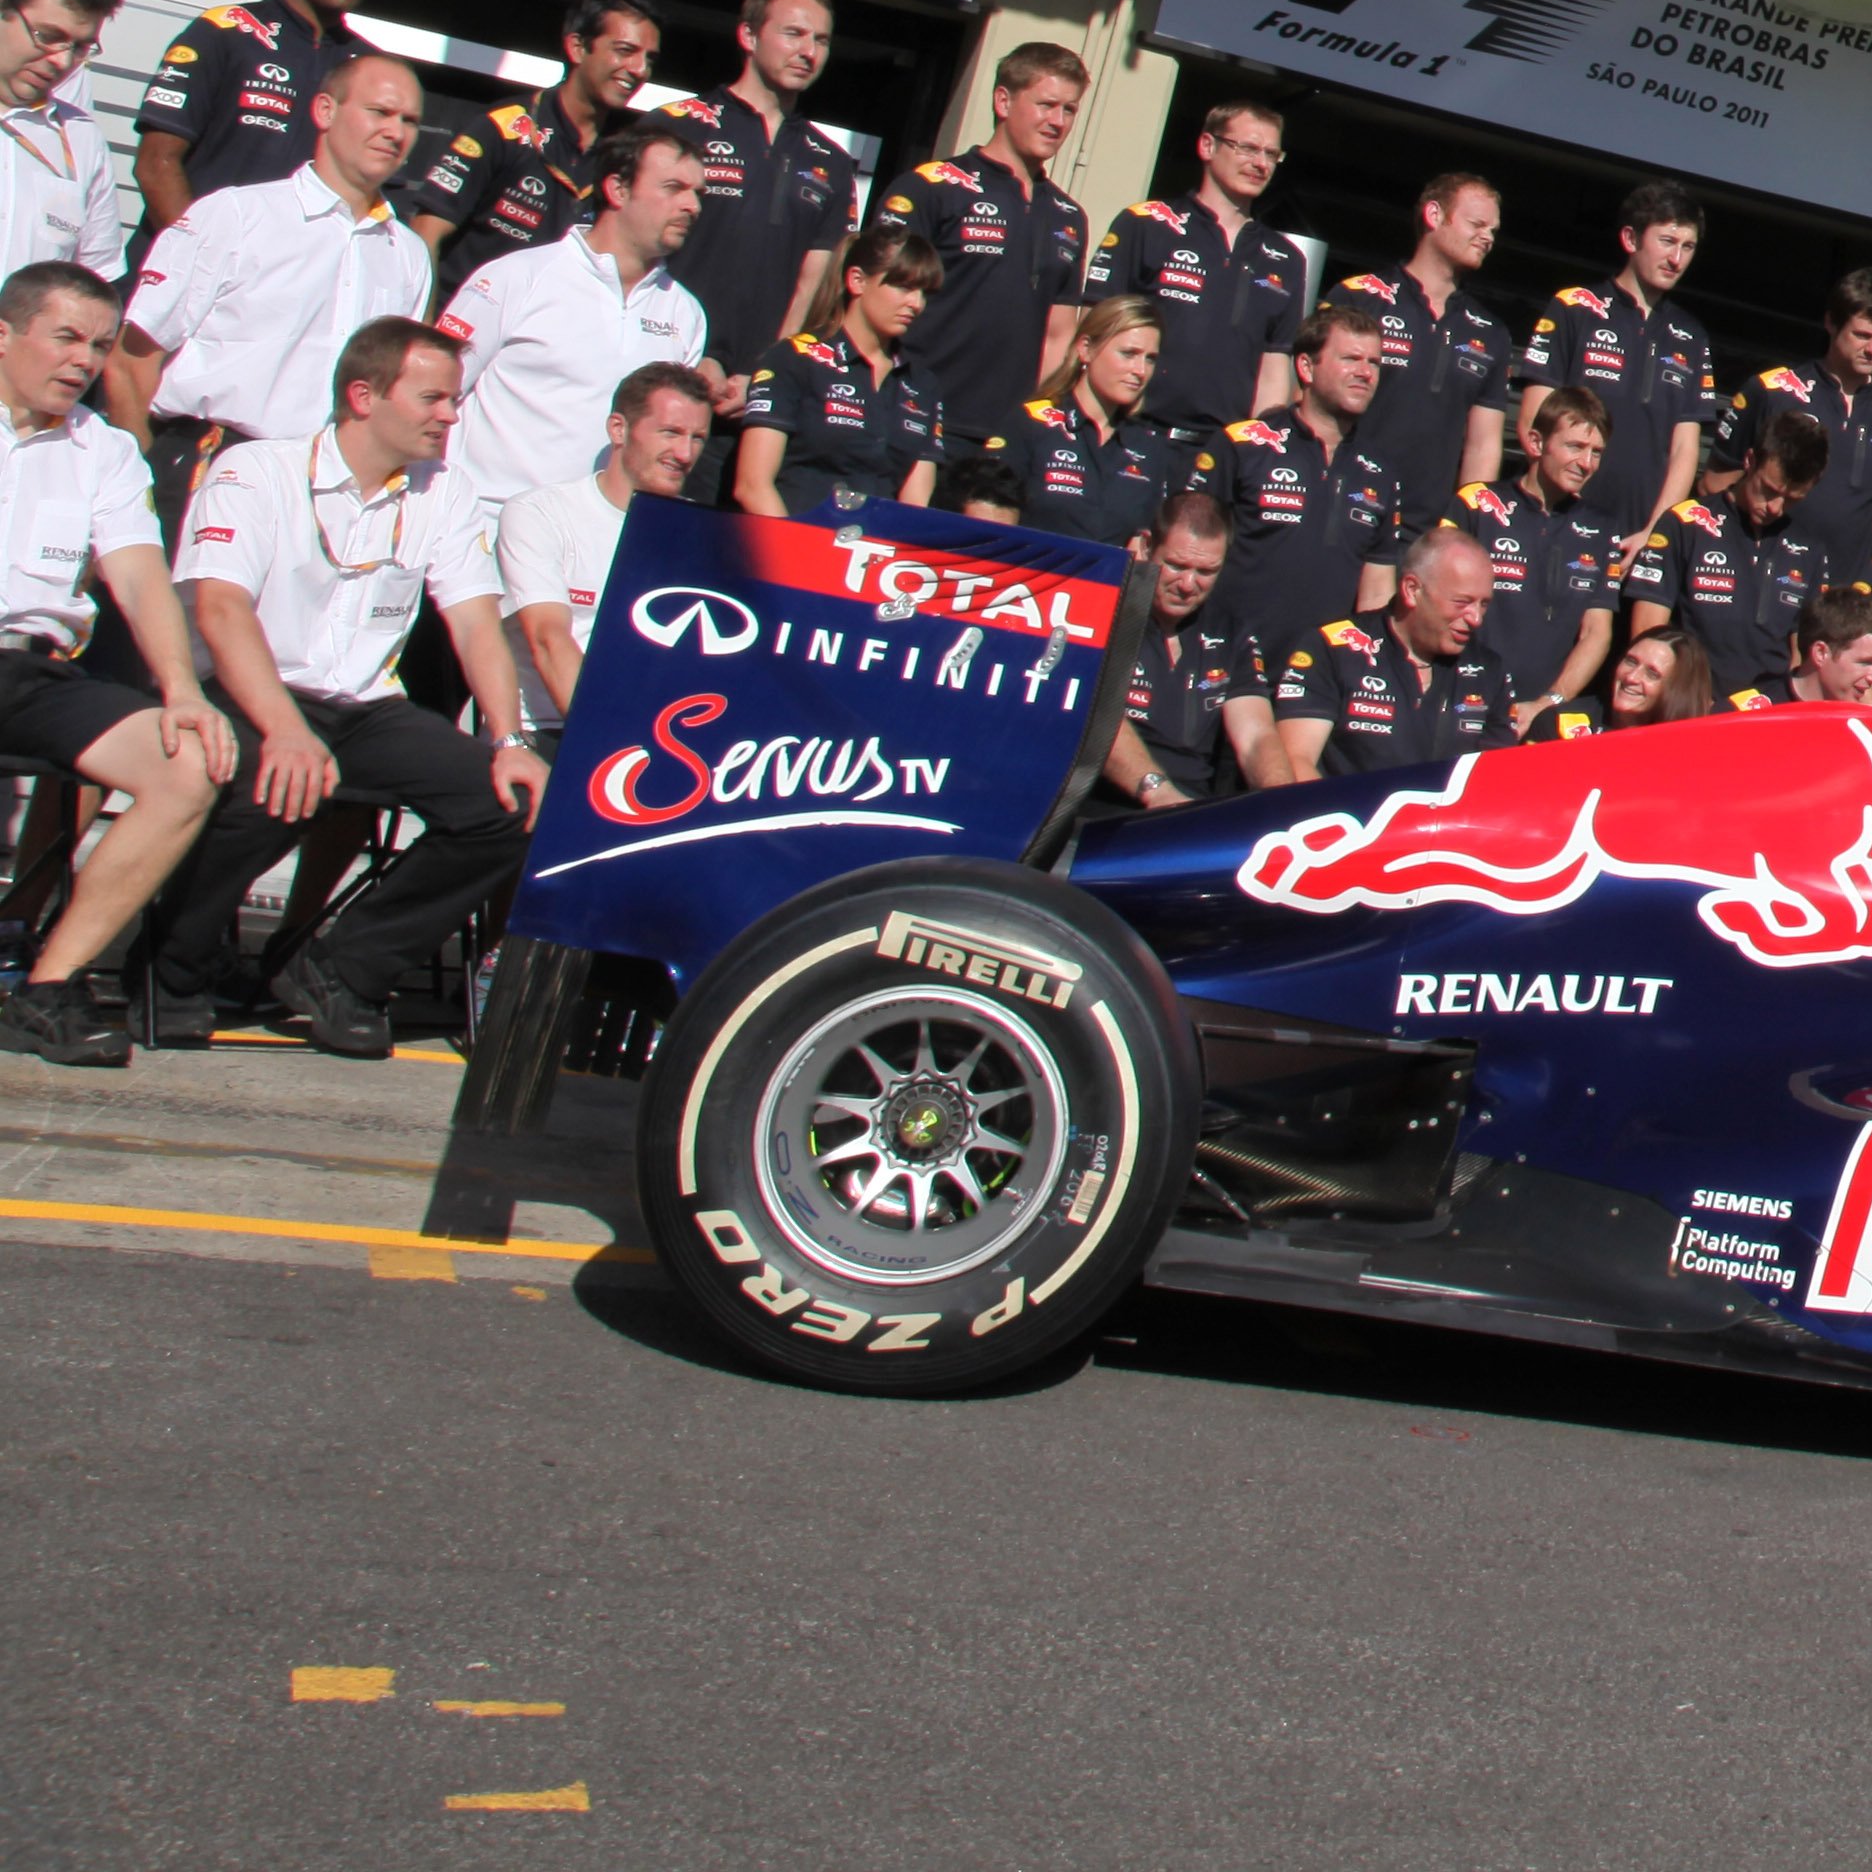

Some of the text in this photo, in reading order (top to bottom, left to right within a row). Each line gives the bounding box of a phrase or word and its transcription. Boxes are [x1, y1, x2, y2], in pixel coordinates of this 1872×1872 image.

[1253, 9, 1451, 78] Formula 1
[1660, 3, 1829, 69] PETROBRAS
[1630, 27, 1785, 91] DO BRASIL
[245, 80, 297, 97] INFINITI
[1586, 63, 1769, 129] SÃO PAULO 2011
[246, 93, 291, 113] TOTAL
[241, 114, 288, 133] GEOX
[501, 201, 538, 225] TOTAL
[964, 217, 1007, 225] INFINITI
[489, 218, 533, 242] GEOX
[966, 229, 1004, 239] TOTAL
[964, 244, 1004, 255] GEOX
[1164, 272, 1201, 288] TOTAL
[1160, 288, 1200, 304] GEOX
[1585, 343, 1625, 354] INFINITI
[1381, 356, 1409, 367] EOX
[1589, 353, 1622, 367] TOTAL
[1585, 368, 1621, 382] GEOX
[832, 402, 863, 416] TOTAL
[827, 416, 865, 428] GEOX
[1051, 472, 1083, 484] TOTAL
[1047, 483, 1084, 496] GEOX
[1262, 484, 1307, 493] INFINITI
[1264, 494, 1303, 506] TOTAL
[1262, 511, 1303, 523] GEOX
[1695, 566, 1736, 576] INFINITI
[834, 532, 1094, 639] TOTAL
[1494, 581, 1522, 592] EOX
[1698, 577, 1732, 588] TOTAL
[1694, 592, 1733, 604] GEOX
[773, 621, 1080, 711] INFINITI
[1353, 703, 1392, 717] TOTAL
[1349, 720, 1392, 734] GEOX
[900, 758, 951, 794] TV
[876, 910, 1083, 1009] PIRELLI
[1395, 974, 1673, 1014] RENAULT
[1692, 1189, 1793, 1220] SIEMENS
[828, 1234, 928, 1264] RACING
[1685, 1227, 1780, 1260] Platform
[1680, 1250, 1796, 1290] Computing
[695, 1210, 1025, 1351] P ZERO
